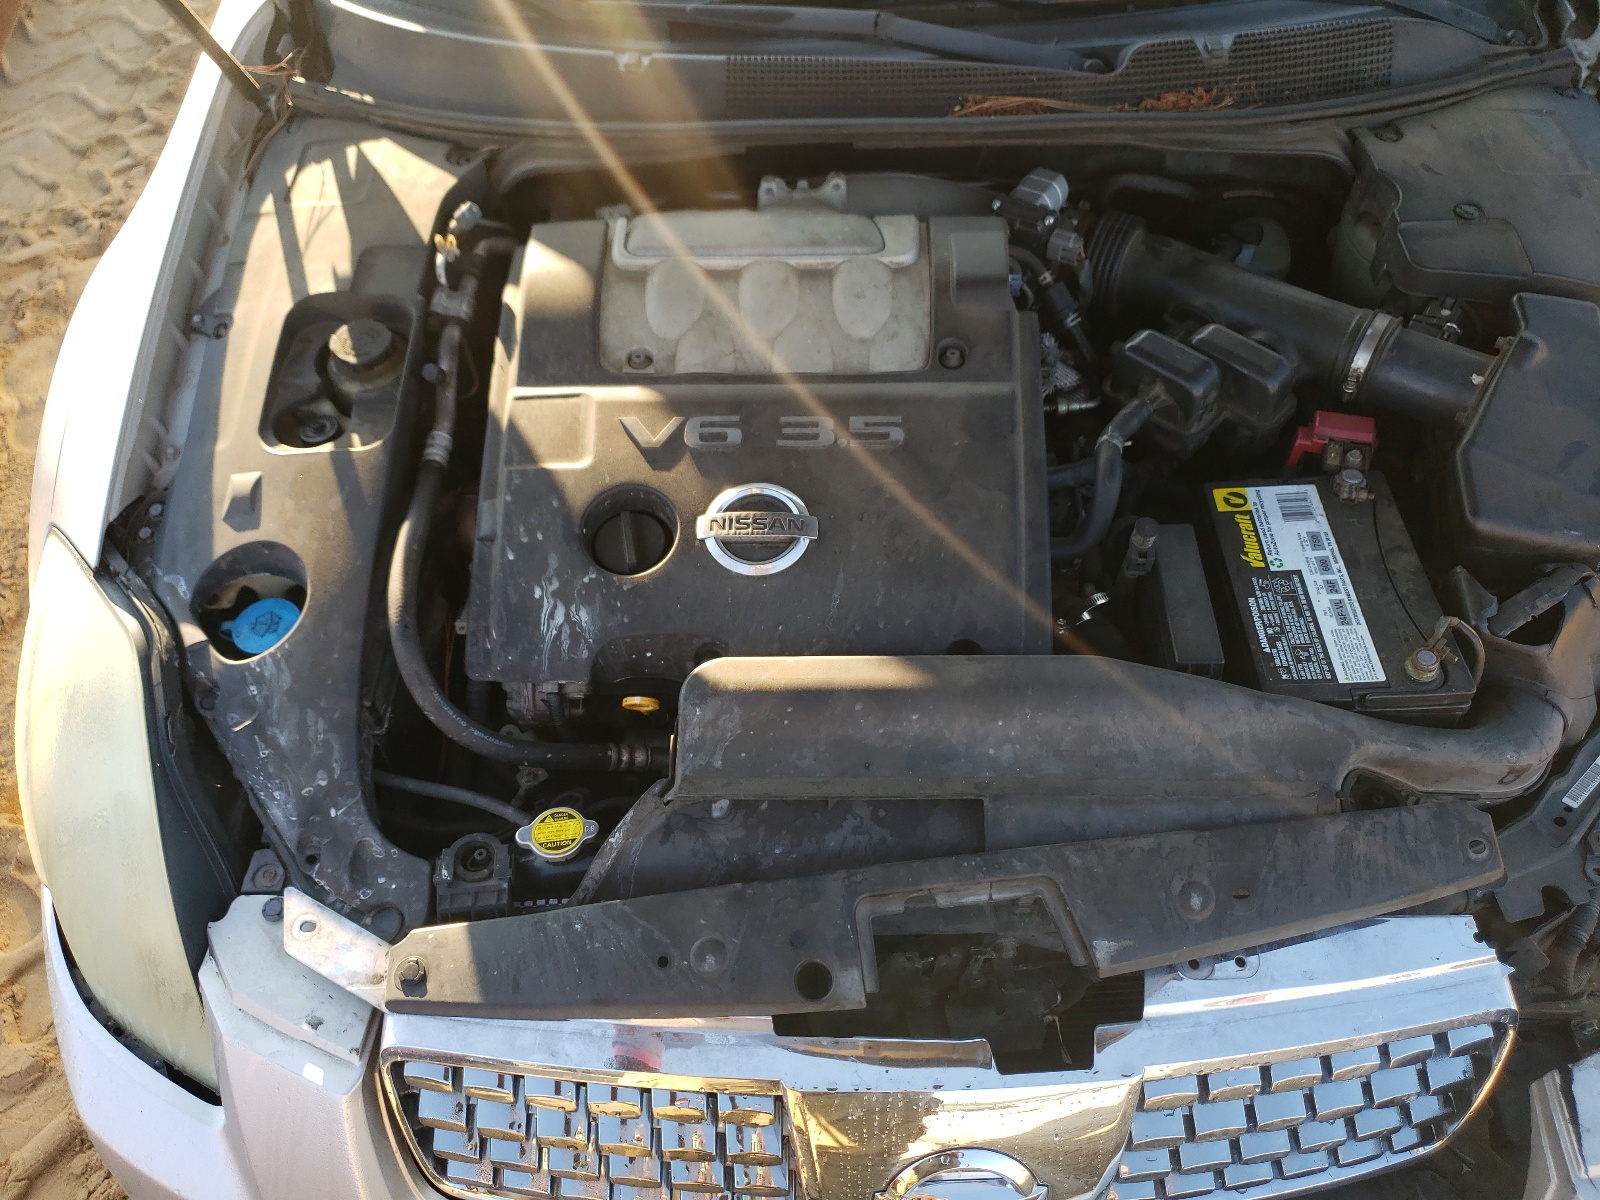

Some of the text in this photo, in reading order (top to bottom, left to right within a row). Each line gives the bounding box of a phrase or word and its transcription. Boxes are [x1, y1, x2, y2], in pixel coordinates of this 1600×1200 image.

[619, 416, 905, 447] V6 3.5
[1255, 490, 1265, 511] recycling
[709, 517, 805, 533] NISSAN
[1255, 509, 1264, 527] batteries
[1262, 511, 1271, 526] proper
[1235, 514, 1265, 567] Valucraft
[1260, 528, 1268, 540] used
[1311, 535, 1321, 547] 750
[1264, 540, 1272, 556] Return
[1270, 535, 1280, 556] AutoZone
[1320, 559, 1330, 572] 600
[1327, 580, 1338, 593] 24F
[1334, 600, 1350, 626] 24F-VL
[543, 840, 572, 848] CAUTION
